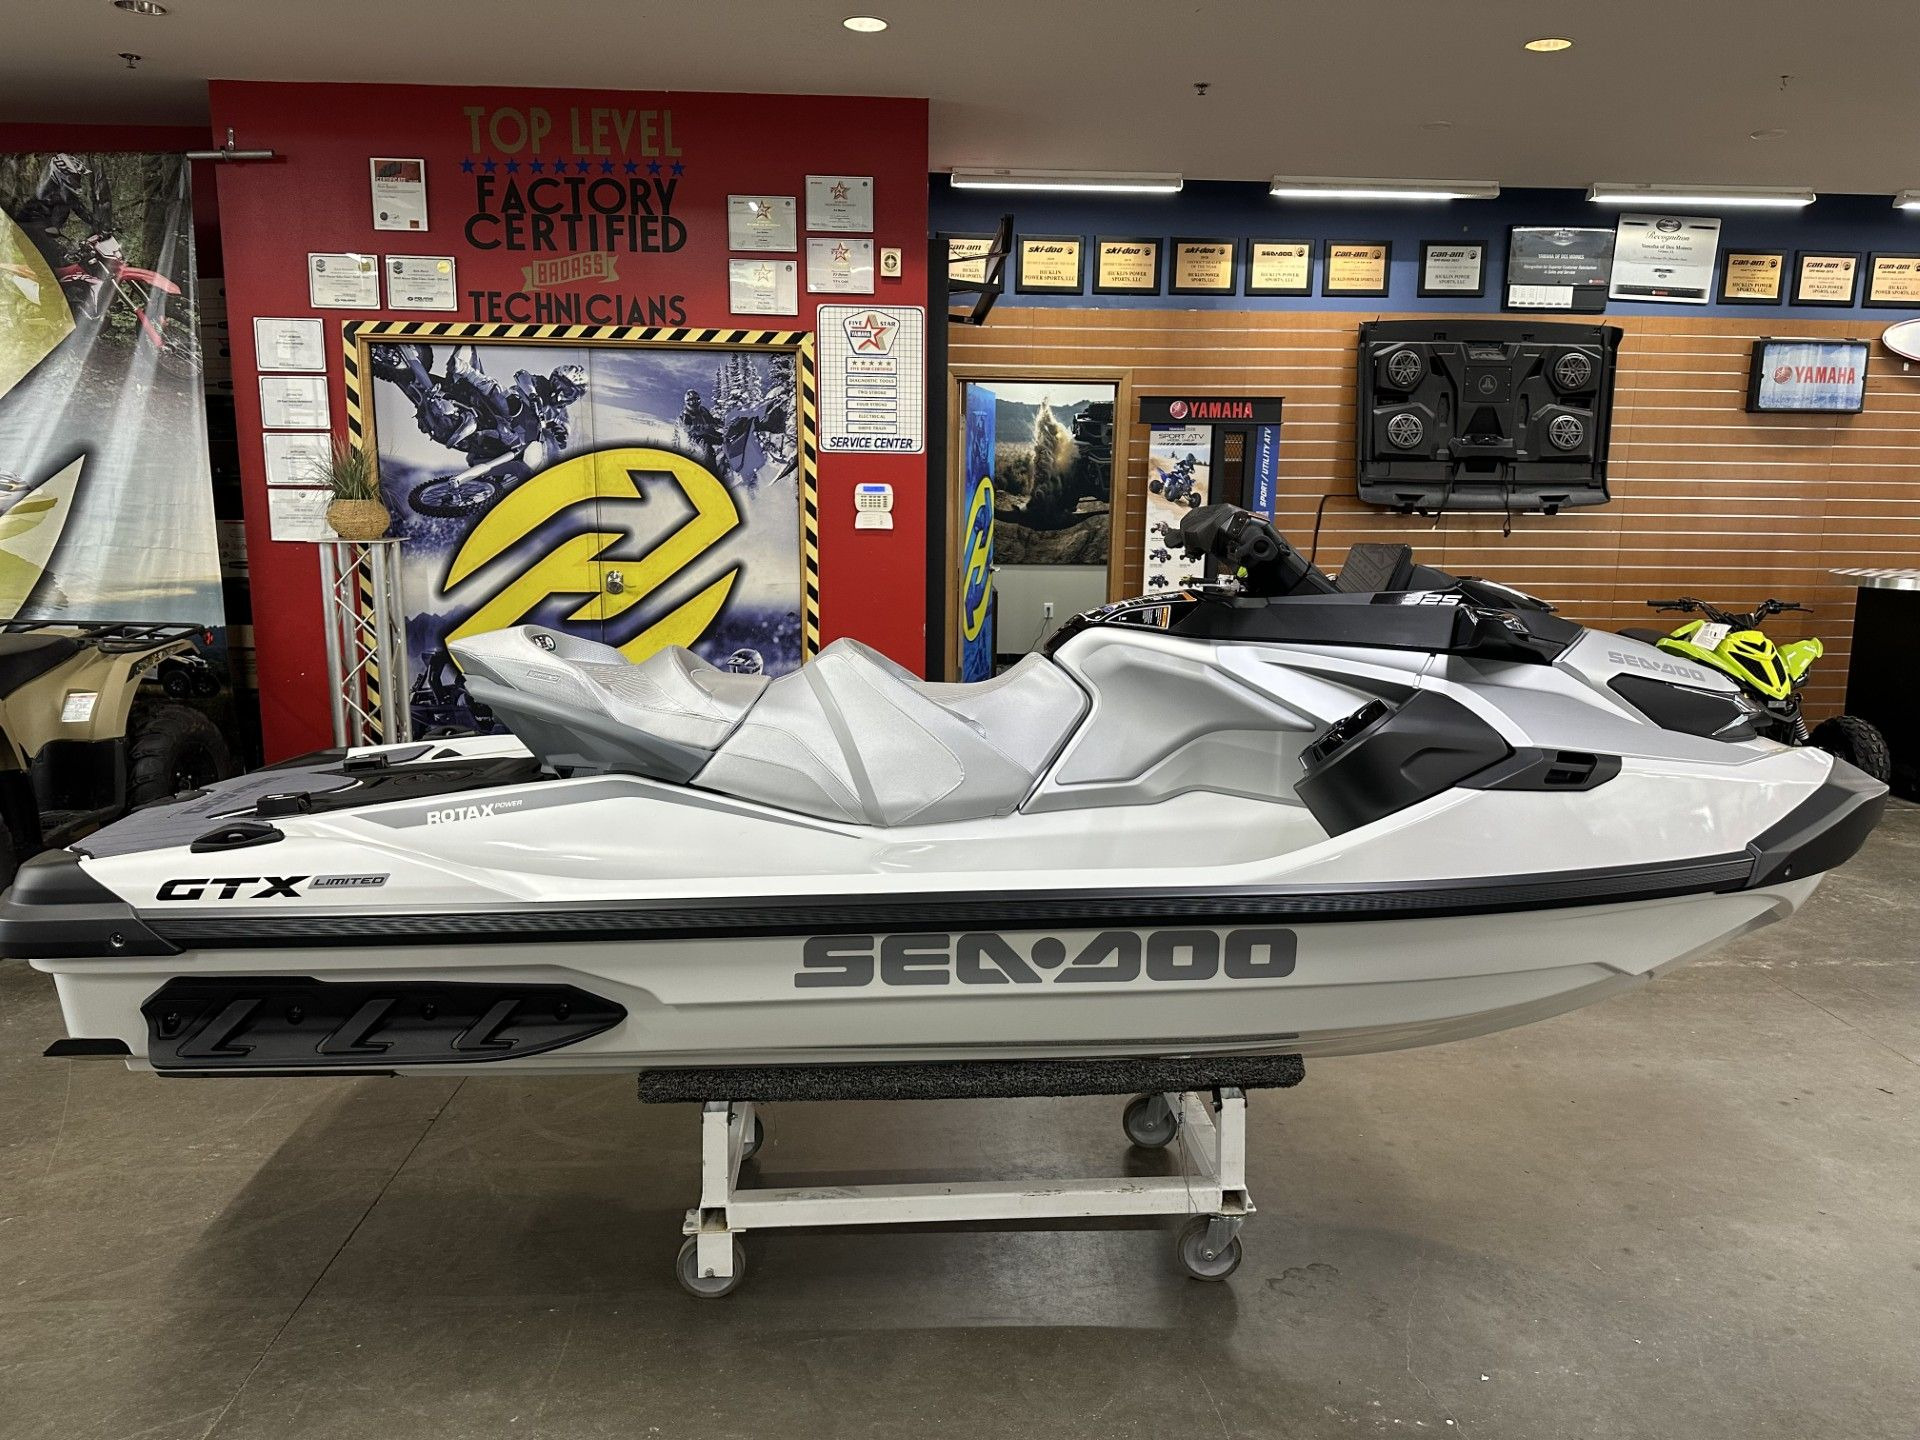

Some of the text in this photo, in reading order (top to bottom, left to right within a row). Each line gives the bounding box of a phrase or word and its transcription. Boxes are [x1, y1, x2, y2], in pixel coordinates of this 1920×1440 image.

[463, 106, 683, 157] TOP LEVEL
[476, 175, 678, 215] FACTORY
[464, 212, 688, 253] CERTIFIED
[1646, 230, 1690, 242] Recognition
[1028, 245, 1063, 253] ski-doo
[1104, 246, 1141, 254] ski-doo
[1184, 246, 1216, 254] ski-doo
[1334, 250, 1368, 258] can-am
[538, 252, 604, 284] BADASS
[468, 291, 688, 326] TECHNICIANS
[1795, 367, 1856, 384] YAMAHA
[1189, 402, 1253, 418] YAMAHA
[830, 437, 913, 449] SERVICE CENTER
[1264, 427, 1273, 445] ATV
[1262, 445, 1271, 474] UTILITY
[1260, 481, 1268, 508] SPORT
[426, 800, 523, 826] ROTAX POWER
[156, 875, 386, 900] GTX LIMITED
